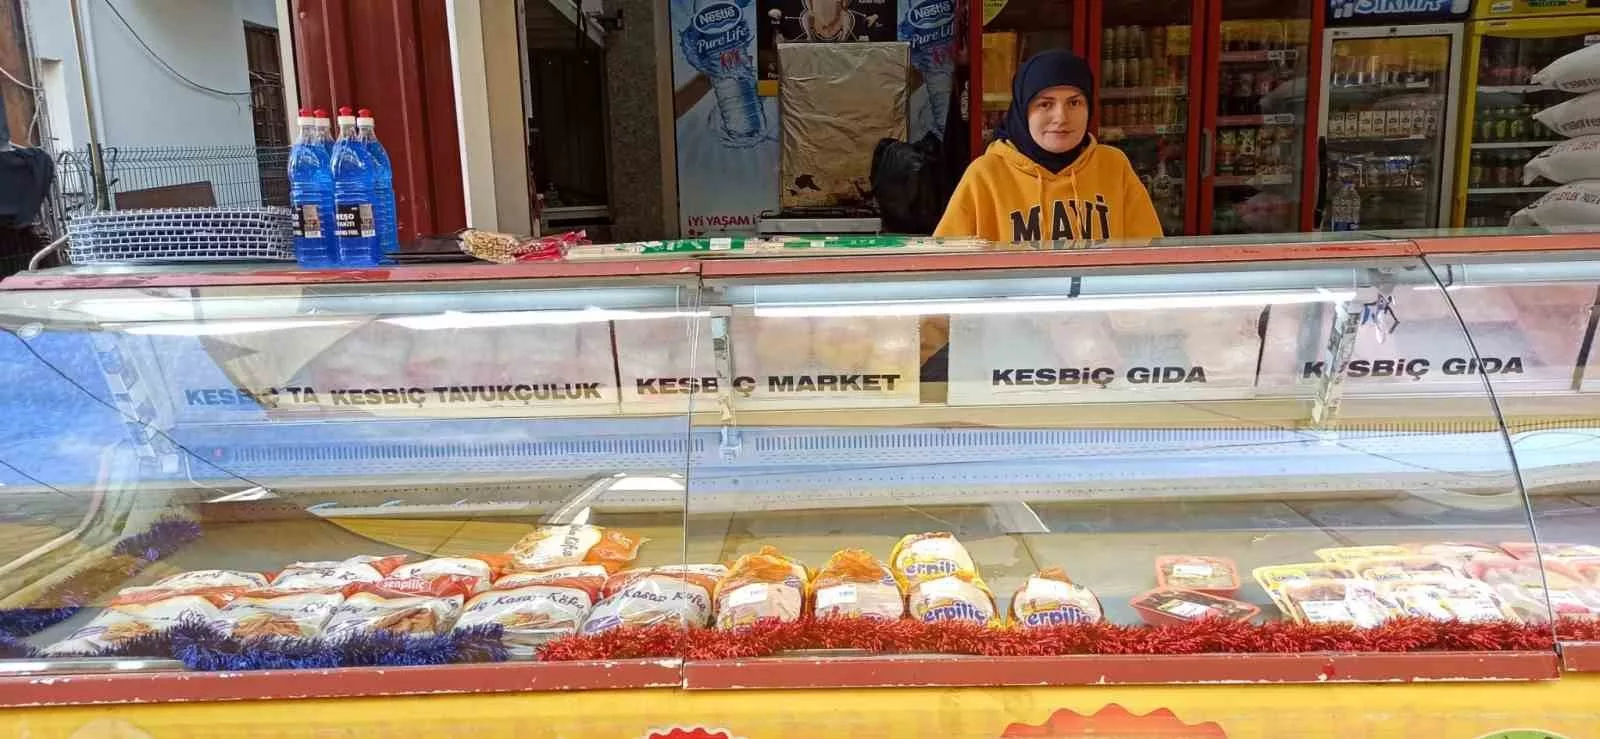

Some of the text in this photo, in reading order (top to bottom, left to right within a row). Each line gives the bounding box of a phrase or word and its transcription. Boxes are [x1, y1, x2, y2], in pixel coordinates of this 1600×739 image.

[1009, 193, 1111, 241] MAVİ
[1126, 366, 1207, 384] GIDA
[1303, 357, 1525, 382] KSBiÇ GIDA
[287, 386, 318, 403] TA
[432, 382, 602, 404] TAVUKÇULUK
[636, 374, 901, 398] KESBÇ MARKET
